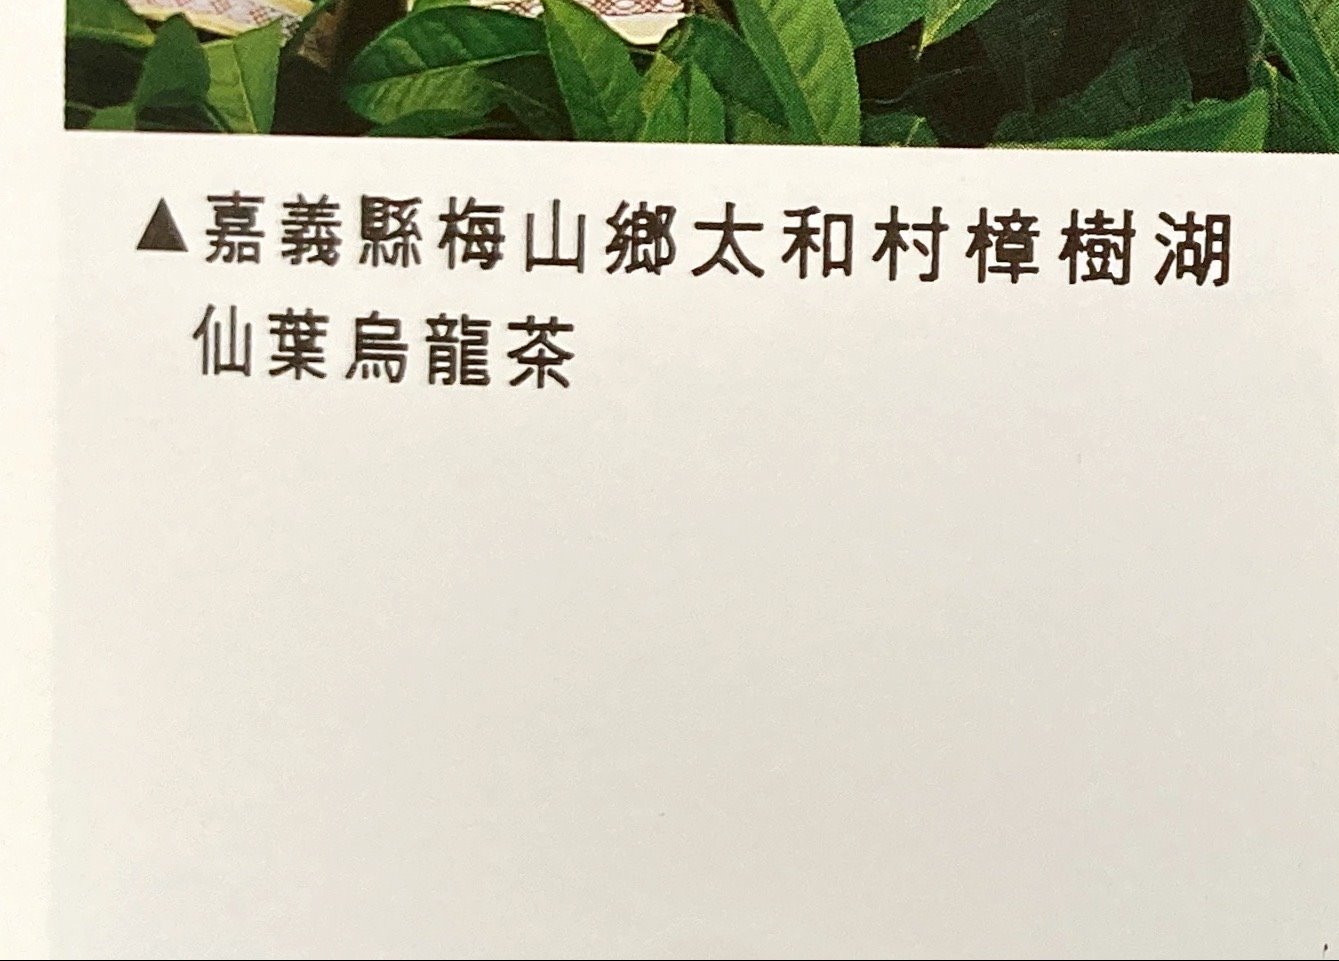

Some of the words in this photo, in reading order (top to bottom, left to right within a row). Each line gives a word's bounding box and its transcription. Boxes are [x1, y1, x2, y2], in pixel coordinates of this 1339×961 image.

[204, 191, 1231, 287] 嘉義縣梅山鄉太和村樟樹湖
[192, 303, 575, 390] 仙葉烏龍茶
